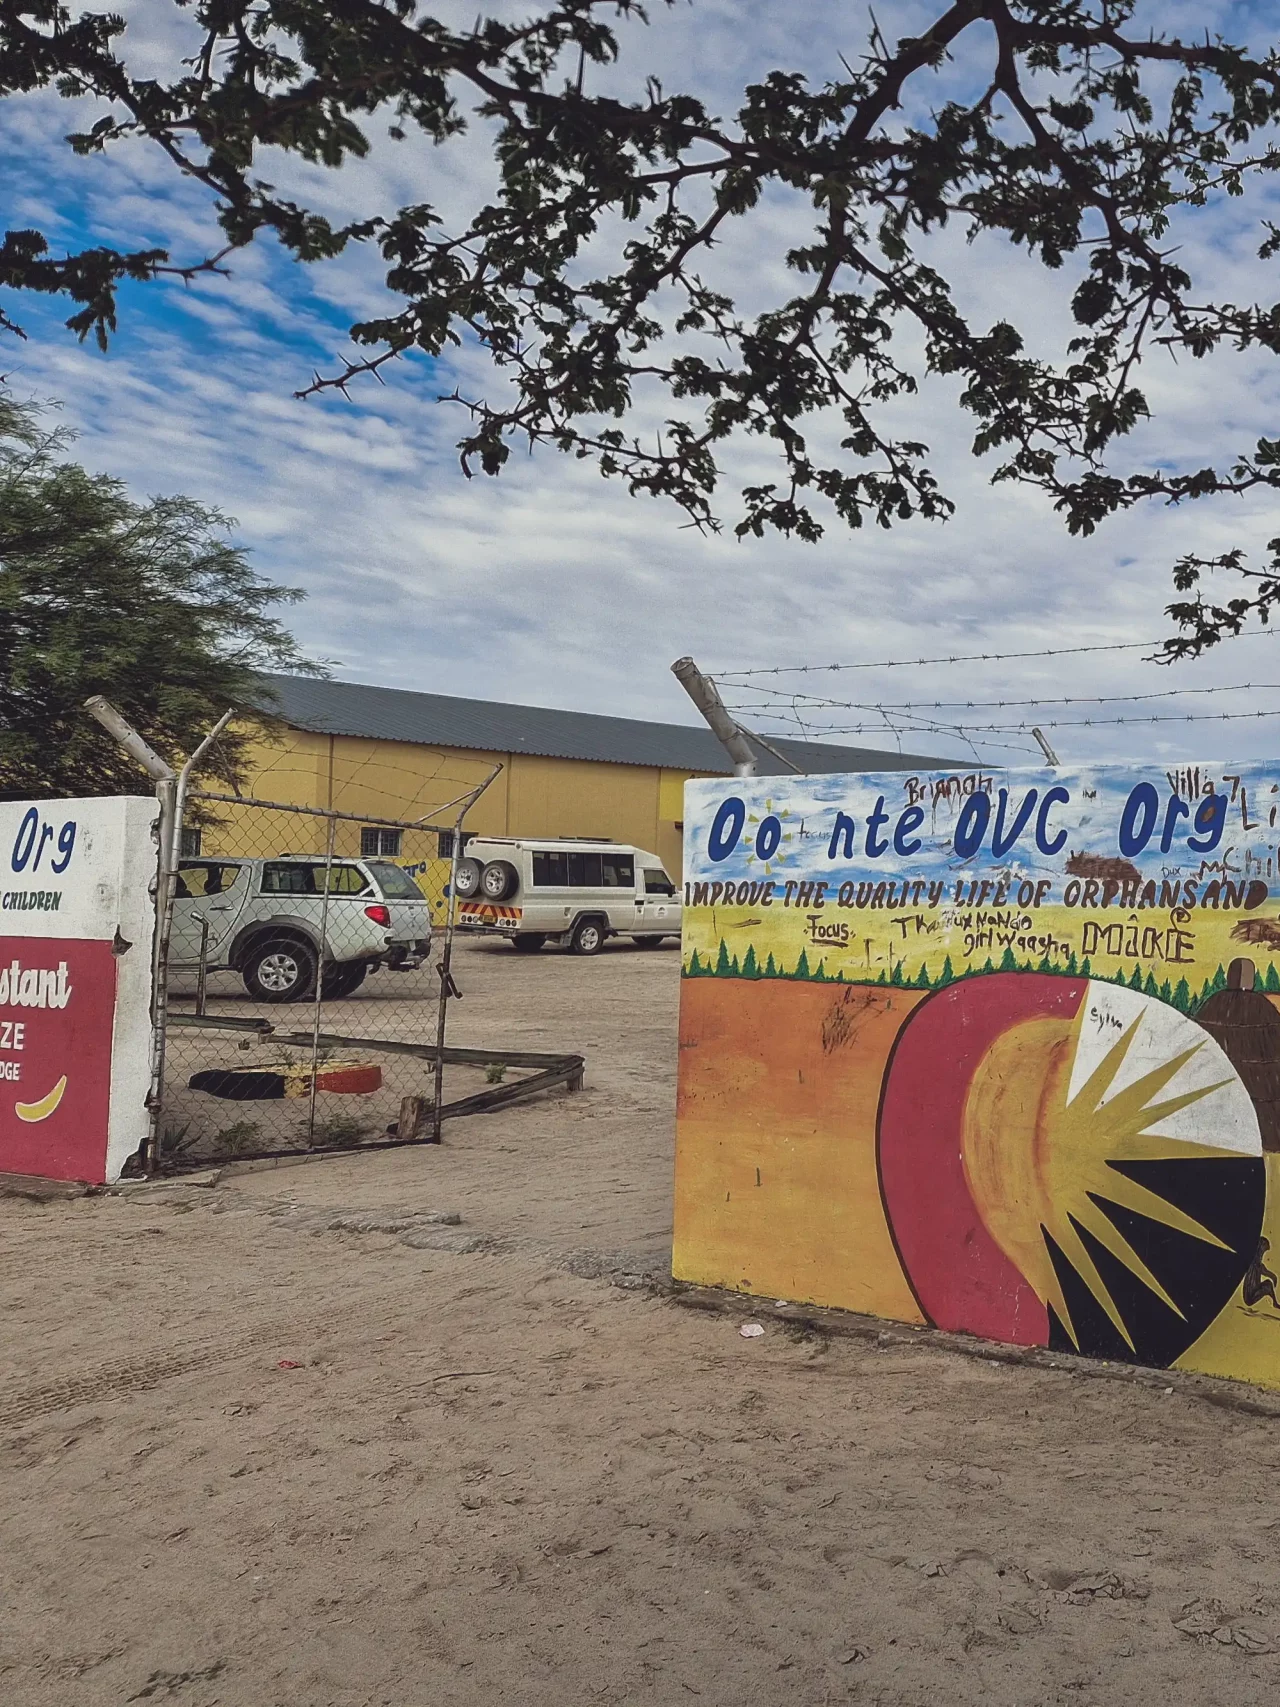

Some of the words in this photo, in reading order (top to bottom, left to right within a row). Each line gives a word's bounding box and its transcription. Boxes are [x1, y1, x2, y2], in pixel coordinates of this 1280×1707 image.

[954, 786, 1070, 859] OVC
[1119, 782, 1229, 858] Org
[11, 807, 77, 874] Org
[2, 890, 62, 912] CHILDREN
[685, 881, 776, 908] IMPROVE
[783, 880, 829, 909] THE
[837, 880, 945, 910] QUALITY
[953, 880, 1011, 908] LIFE
[1018, 880, 1052, 909] OF
[0, 1021, 25, 1050] ZE
